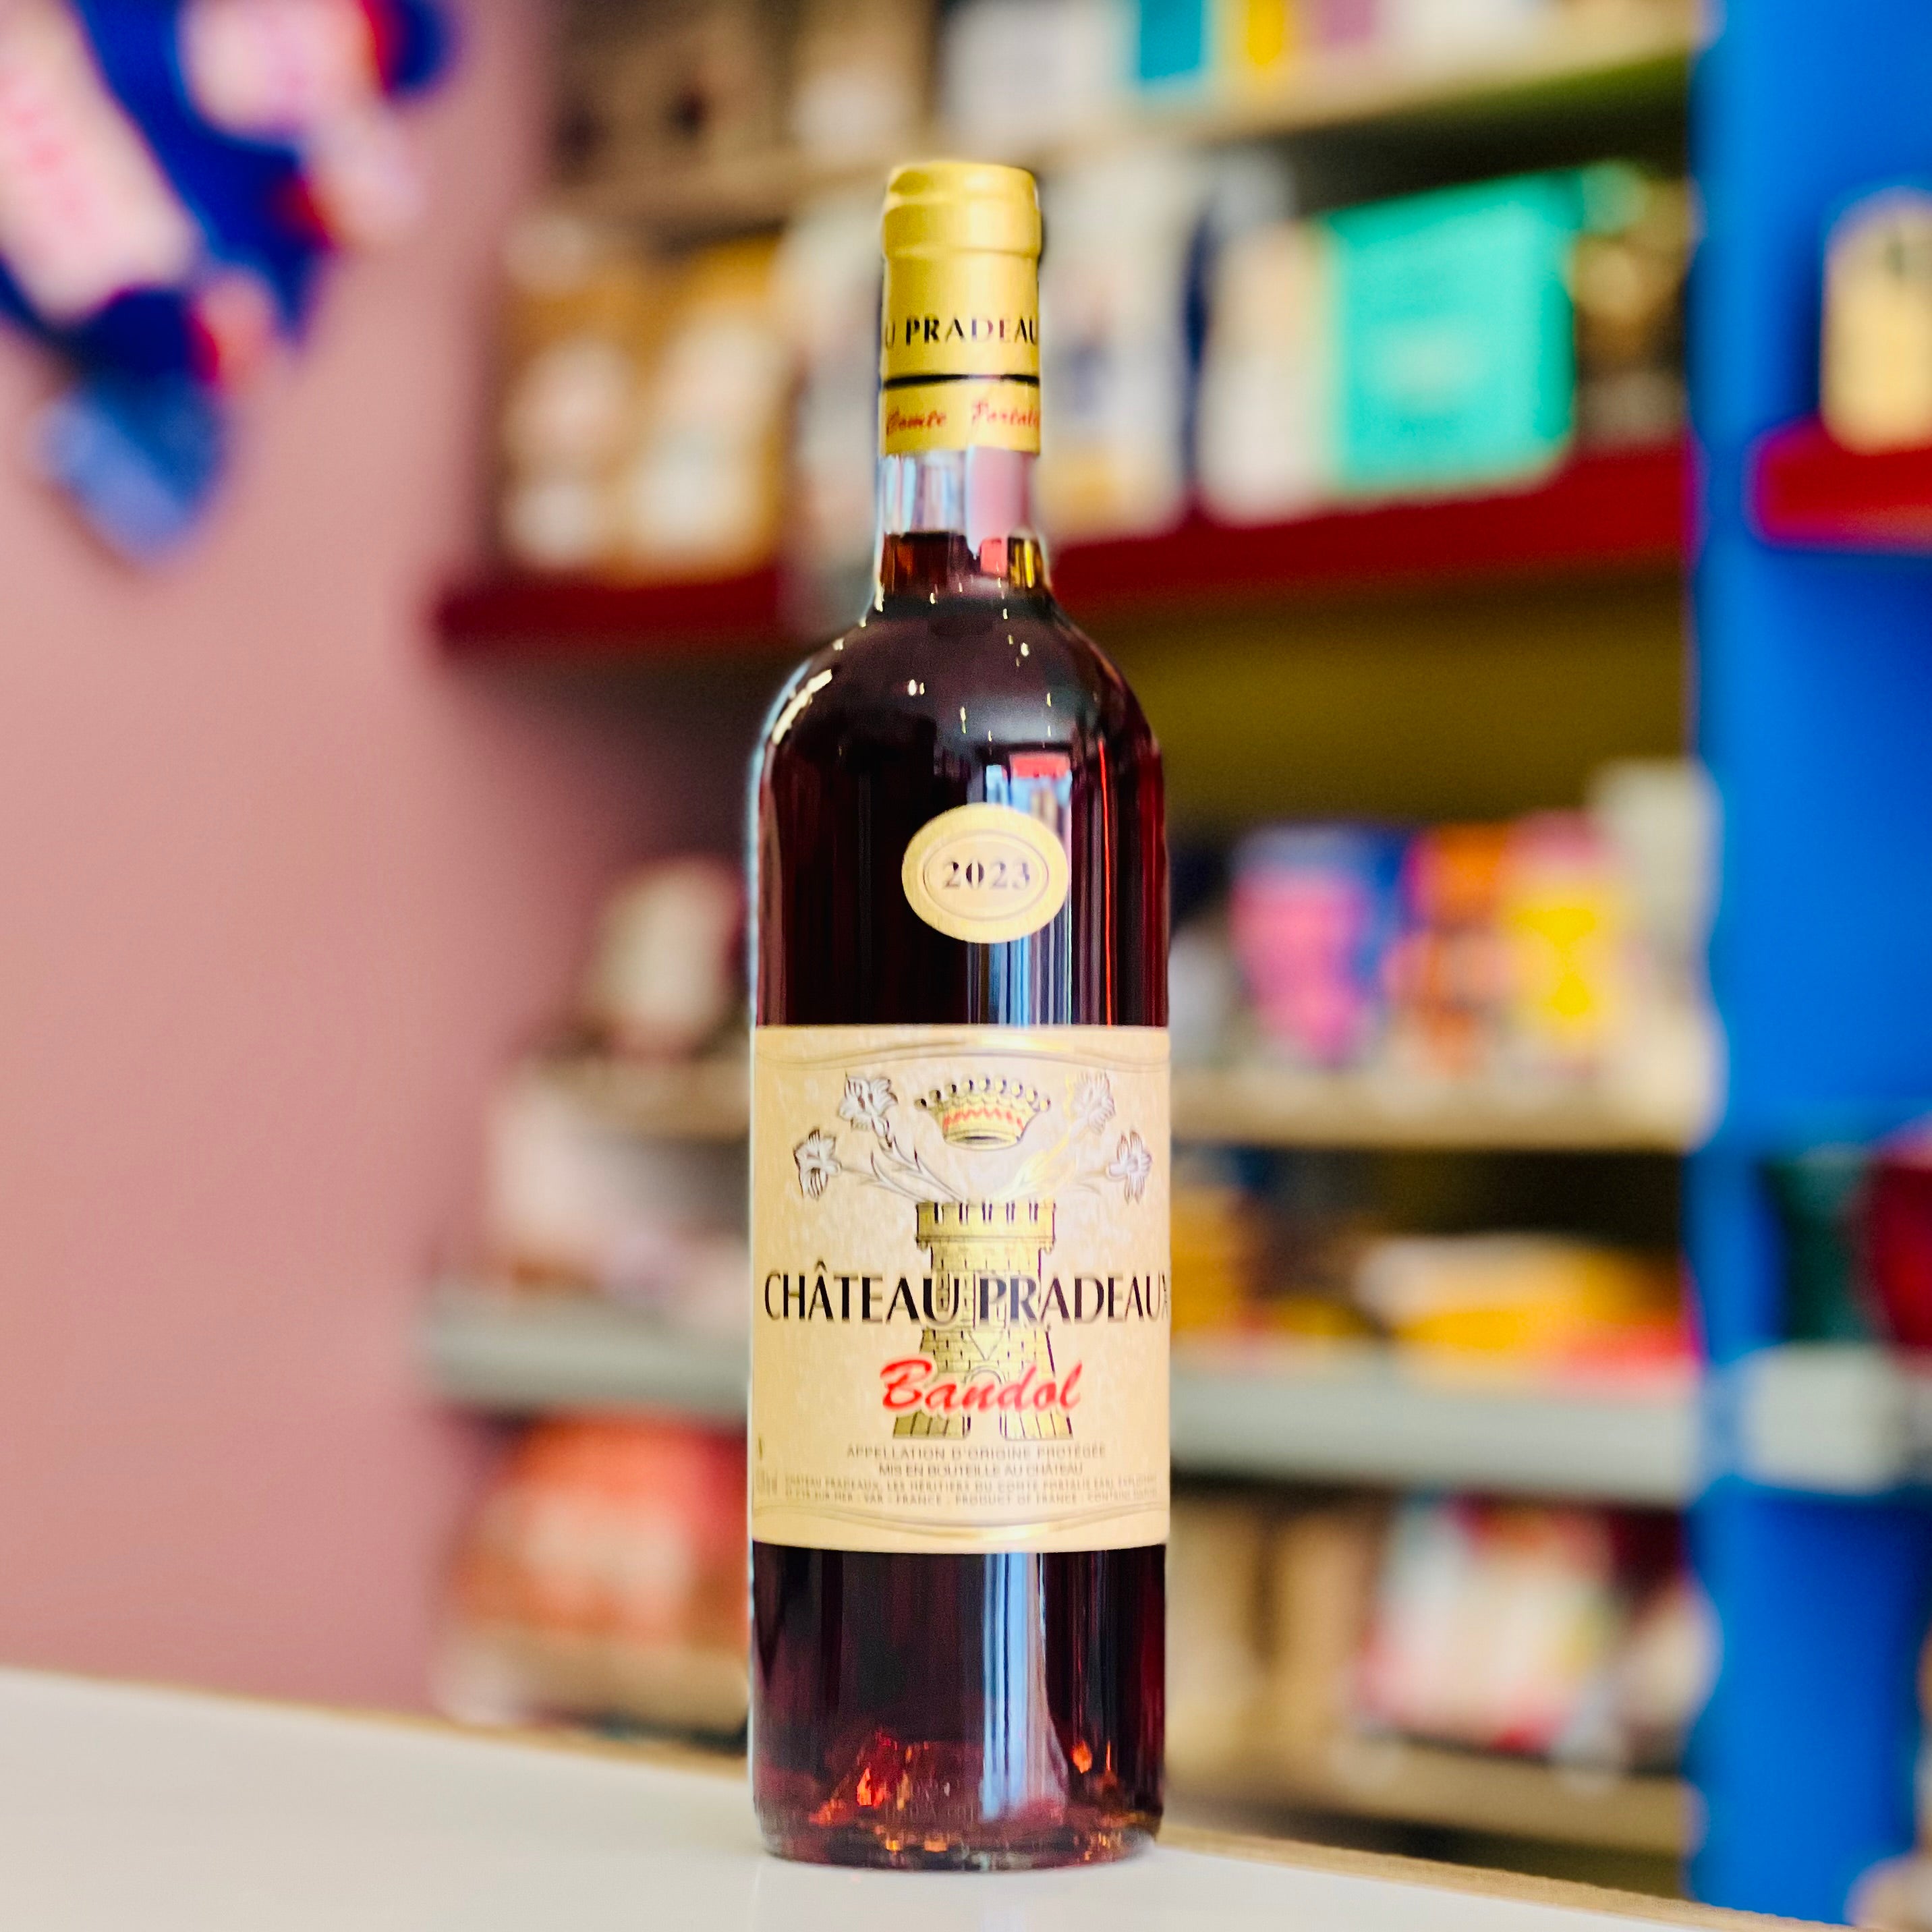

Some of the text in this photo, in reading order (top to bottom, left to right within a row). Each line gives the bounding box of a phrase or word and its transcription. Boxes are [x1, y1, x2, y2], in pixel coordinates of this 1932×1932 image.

[944, 858, 1030, 889] 2023
[764, 1257, 960, 1326] CHÂTEAU
[879, 1357, 1083, 1412] Bandol
[847, 1443, 945, 1460] APPELLATION
[879, 1463, 902, 1477] MIS
[928, 1464, 1001, 1478] BOUTEILLE
[1005, 1465, 1023, 1477] AU
